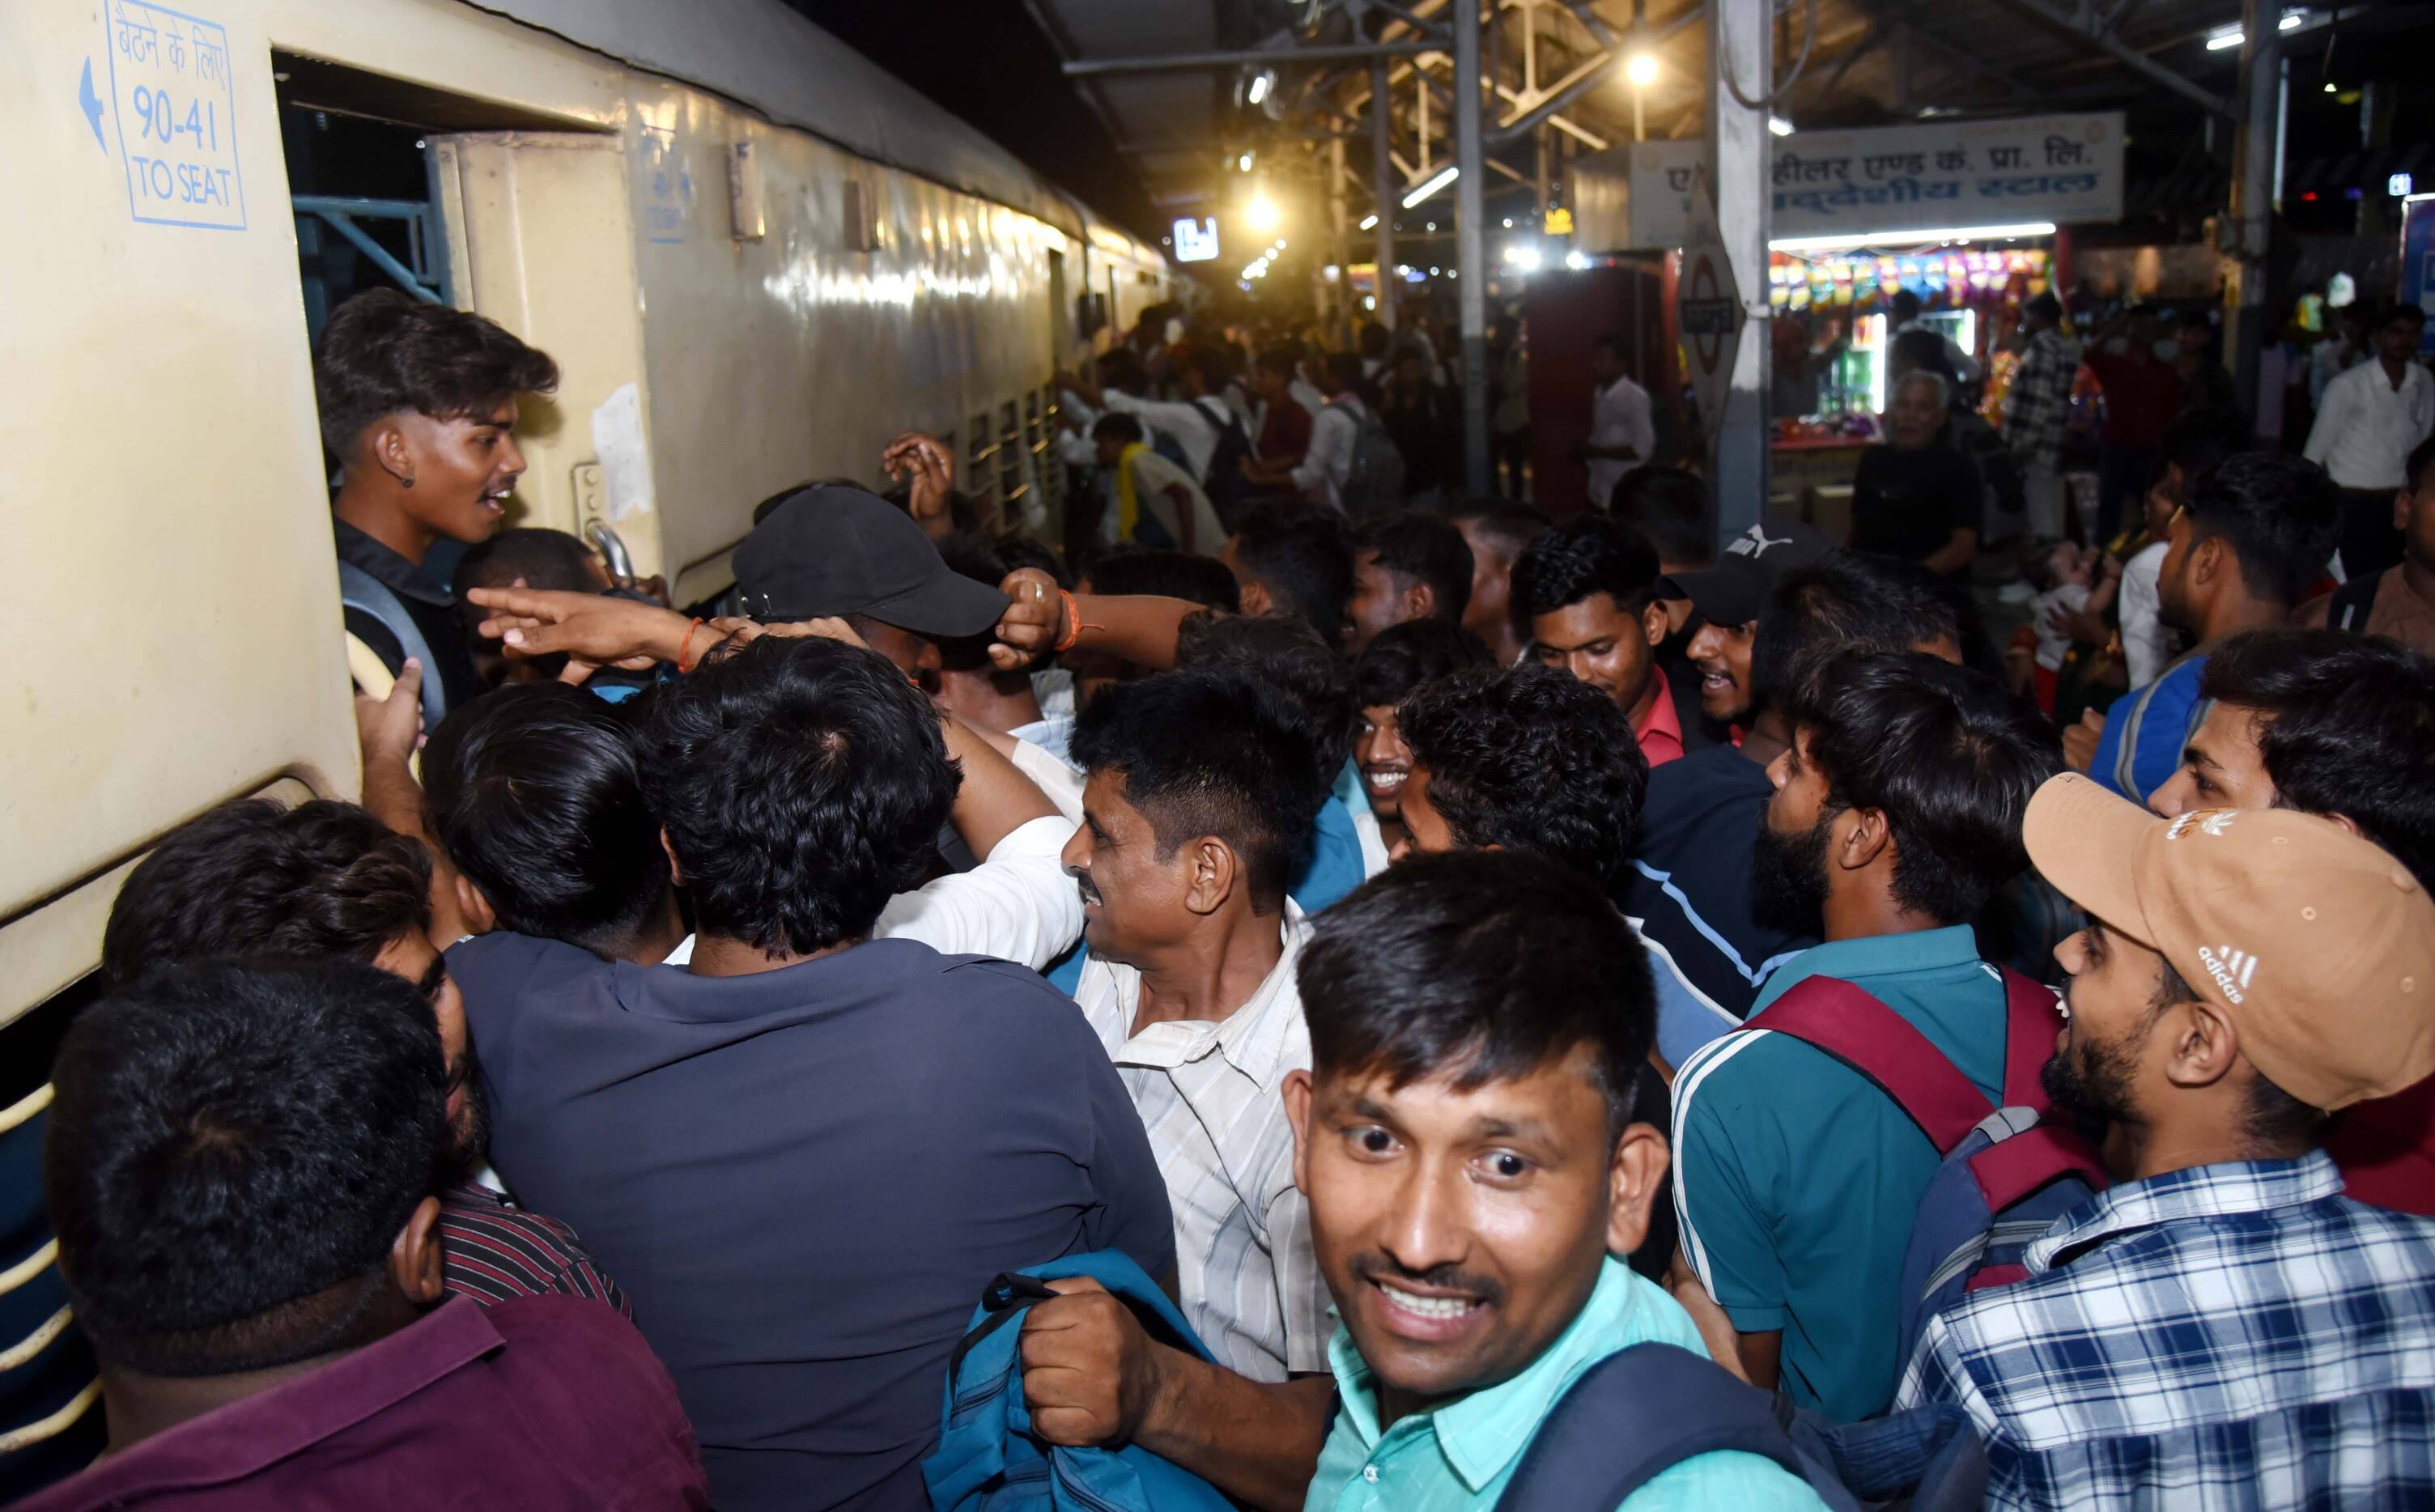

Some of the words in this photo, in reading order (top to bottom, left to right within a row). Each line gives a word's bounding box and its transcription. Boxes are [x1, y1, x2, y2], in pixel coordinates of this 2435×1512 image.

[116, 1, 159, 70] बैठने
[165, 17, 185, 74] के
[192, 25, 225, 91] लिए
[133, 84, 217, 152] 90-41
[132, 155, 173, 200] TO
[177, 162, 231, 206] SEAT
[1772, 151, 1852, 186] हीलर
[1863, 151, 1926, 181] एण्ड
[1977, 171, 2102, 198] स्टाल
[2197, 945, 2244, 1004] adidas
